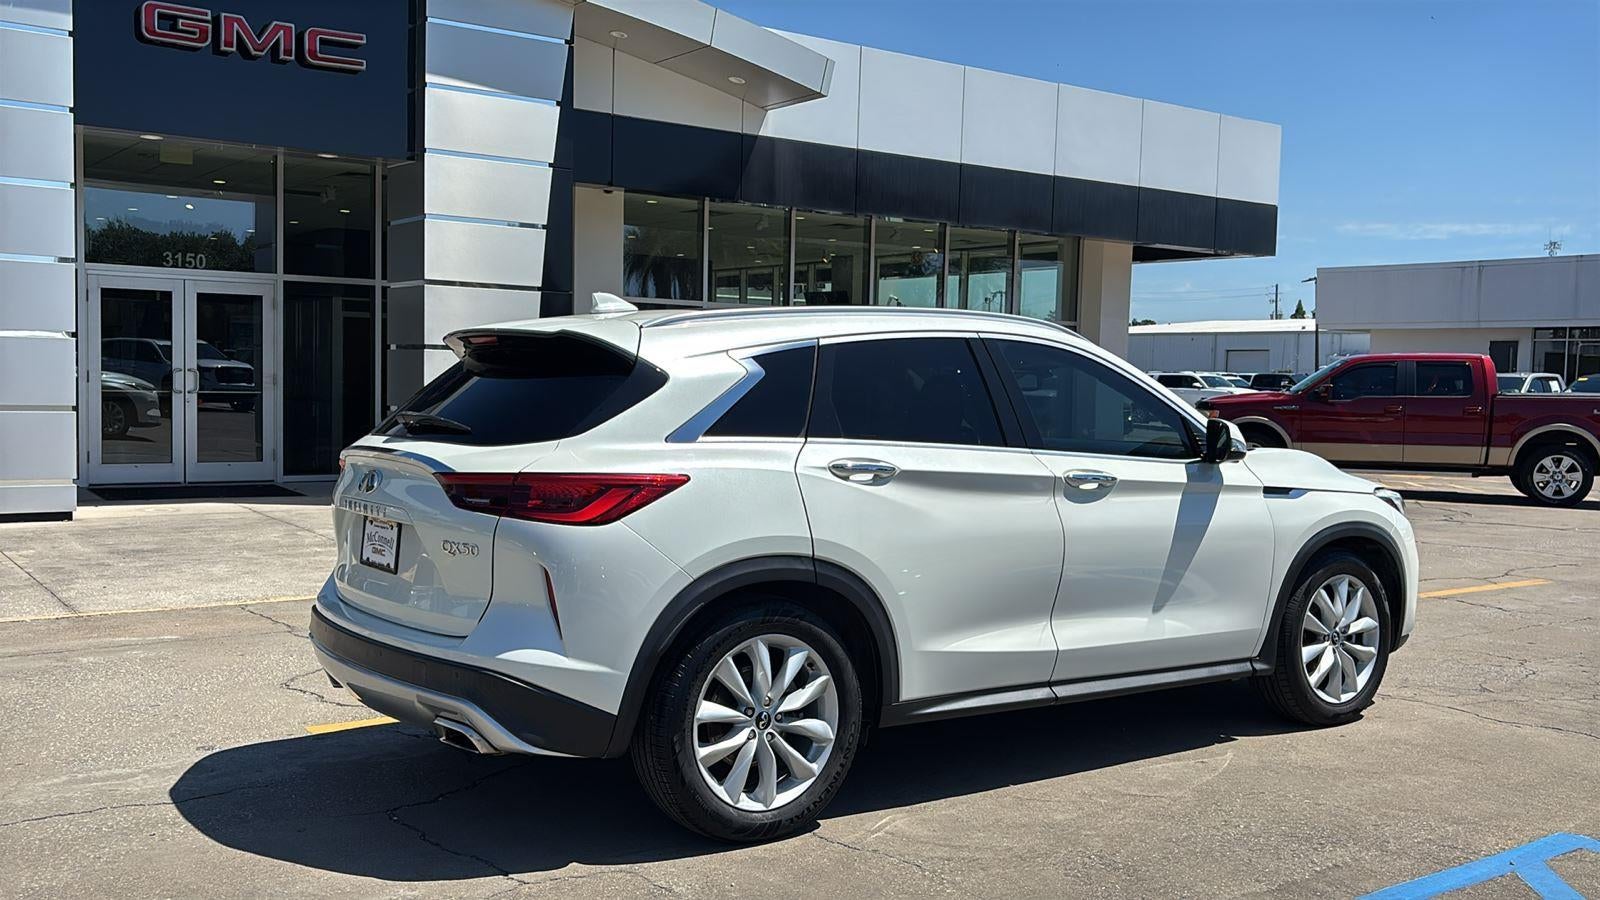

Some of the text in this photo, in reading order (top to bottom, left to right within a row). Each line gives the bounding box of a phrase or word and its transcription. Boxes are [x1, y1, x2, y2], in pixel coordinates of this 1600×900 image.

[140, 0, 367, 71] GMC
[162, 251, 206, 269] 3150
[366, 530, 395, 550] McConnell
[441, 539, 480, 557] QX50
[371, 546, 386, 557] GMC
